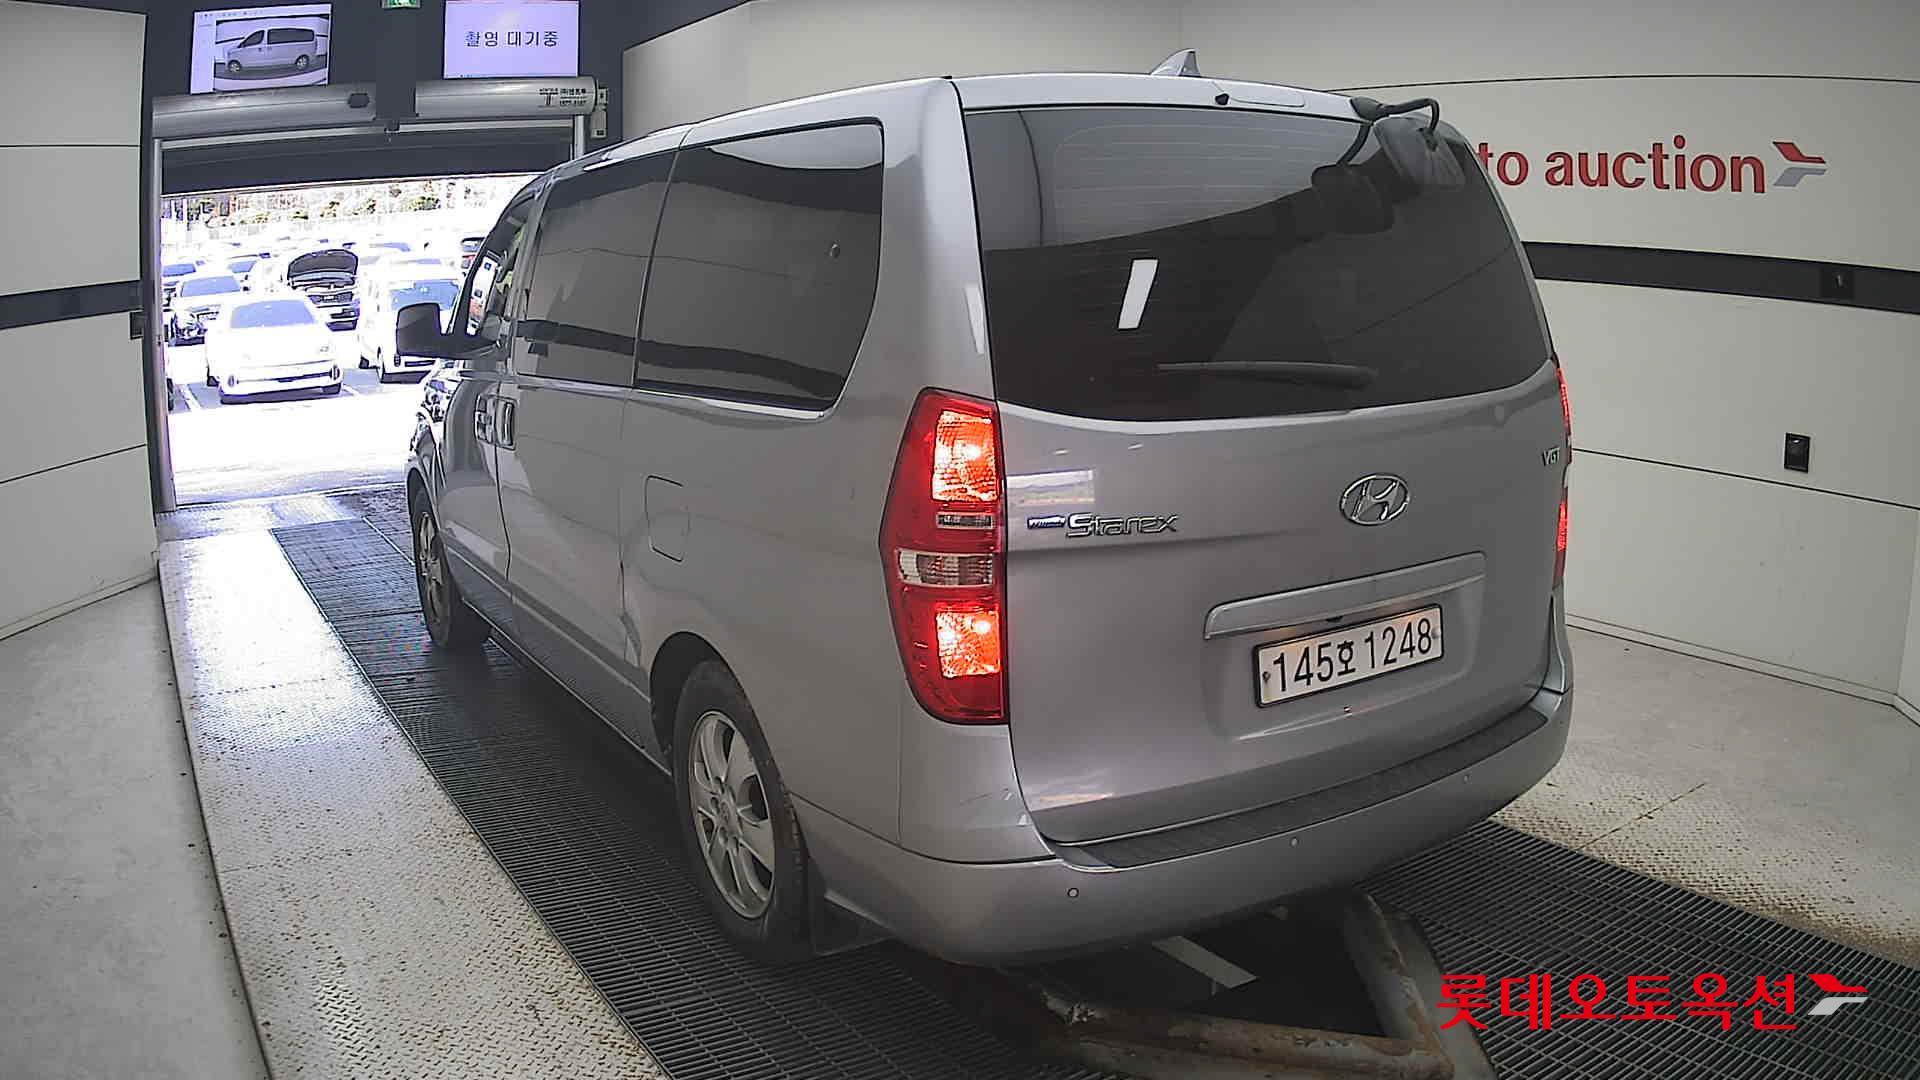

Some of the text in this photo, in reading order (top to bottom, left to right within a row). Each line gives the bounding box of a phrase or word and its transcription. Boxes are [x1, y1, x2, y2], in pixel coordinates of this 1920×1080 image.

[464, 31, 560, 47] 촬영 대기중
[1545, 134, 1765, 193] auction
[1542, 447, 1560, 466] VGT
[1066, 512, 1179, 538] Starex
[1364, 617, 1432, 669] 1248
